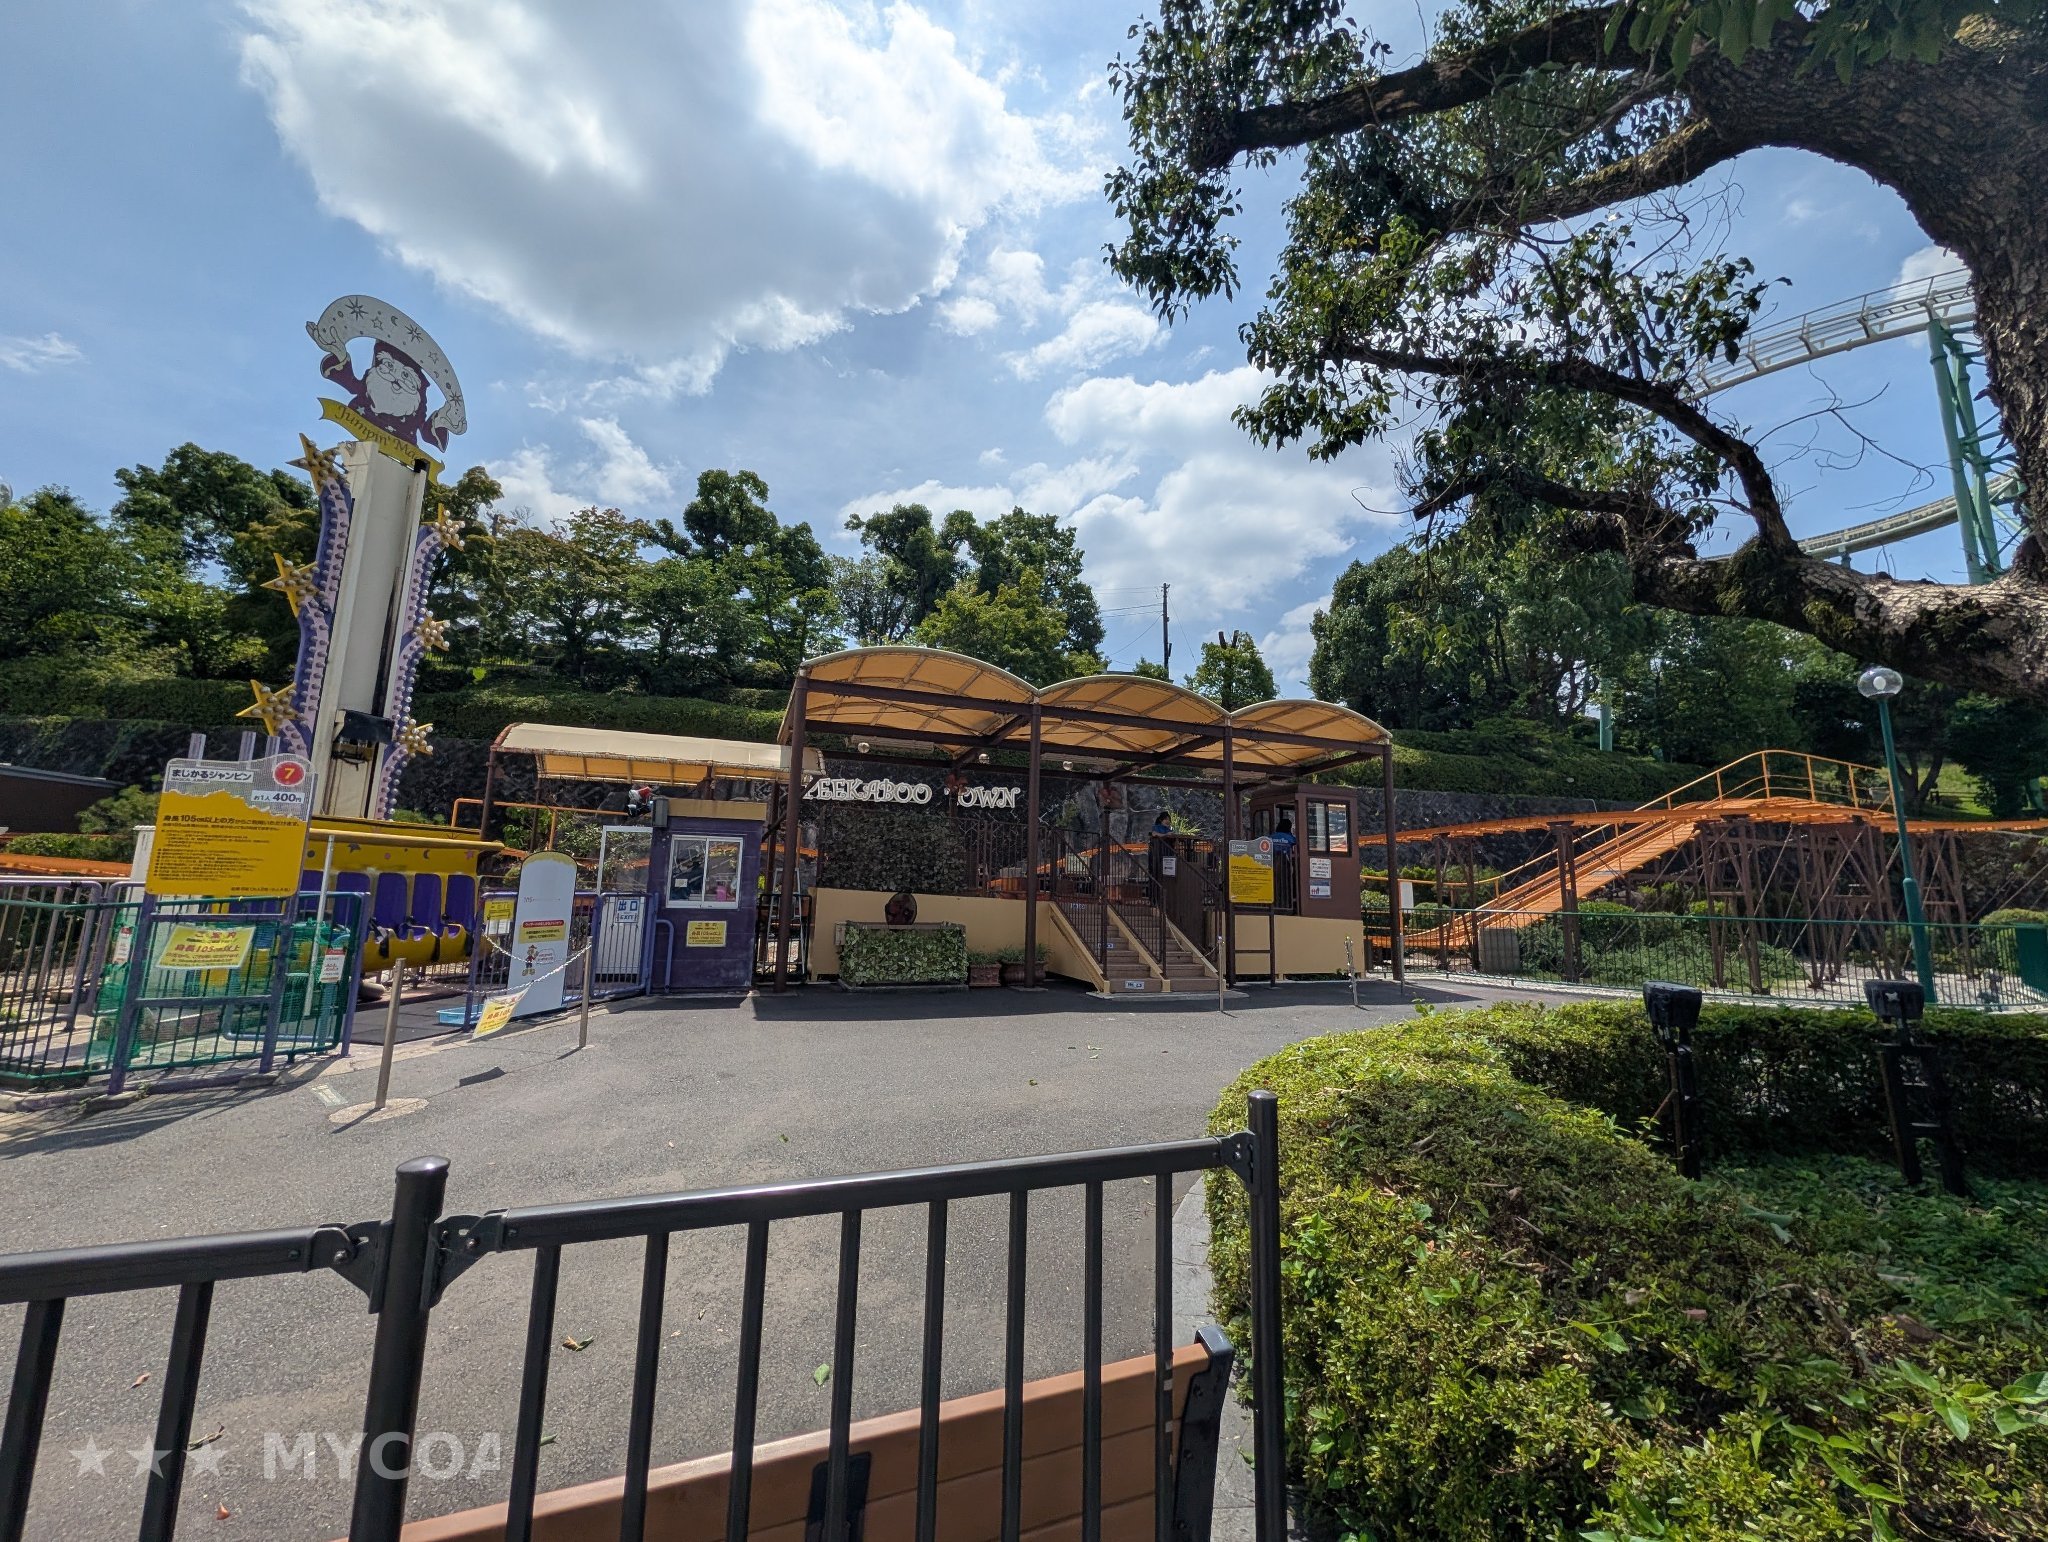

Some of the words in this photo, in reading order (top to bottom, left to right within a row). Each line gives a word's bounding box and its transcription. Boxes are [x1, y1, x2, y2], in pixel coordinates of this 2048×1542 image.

[335, 405, 390, 445] Jumpin'
[172, 768, 252, 781] まじかるジャンピン
[284, 767, 295, 780] 7
[272, 793, 302, 803] 400円
[944, 786, 1021, 809] OWN
[618, 900, 638, 911] 出口
